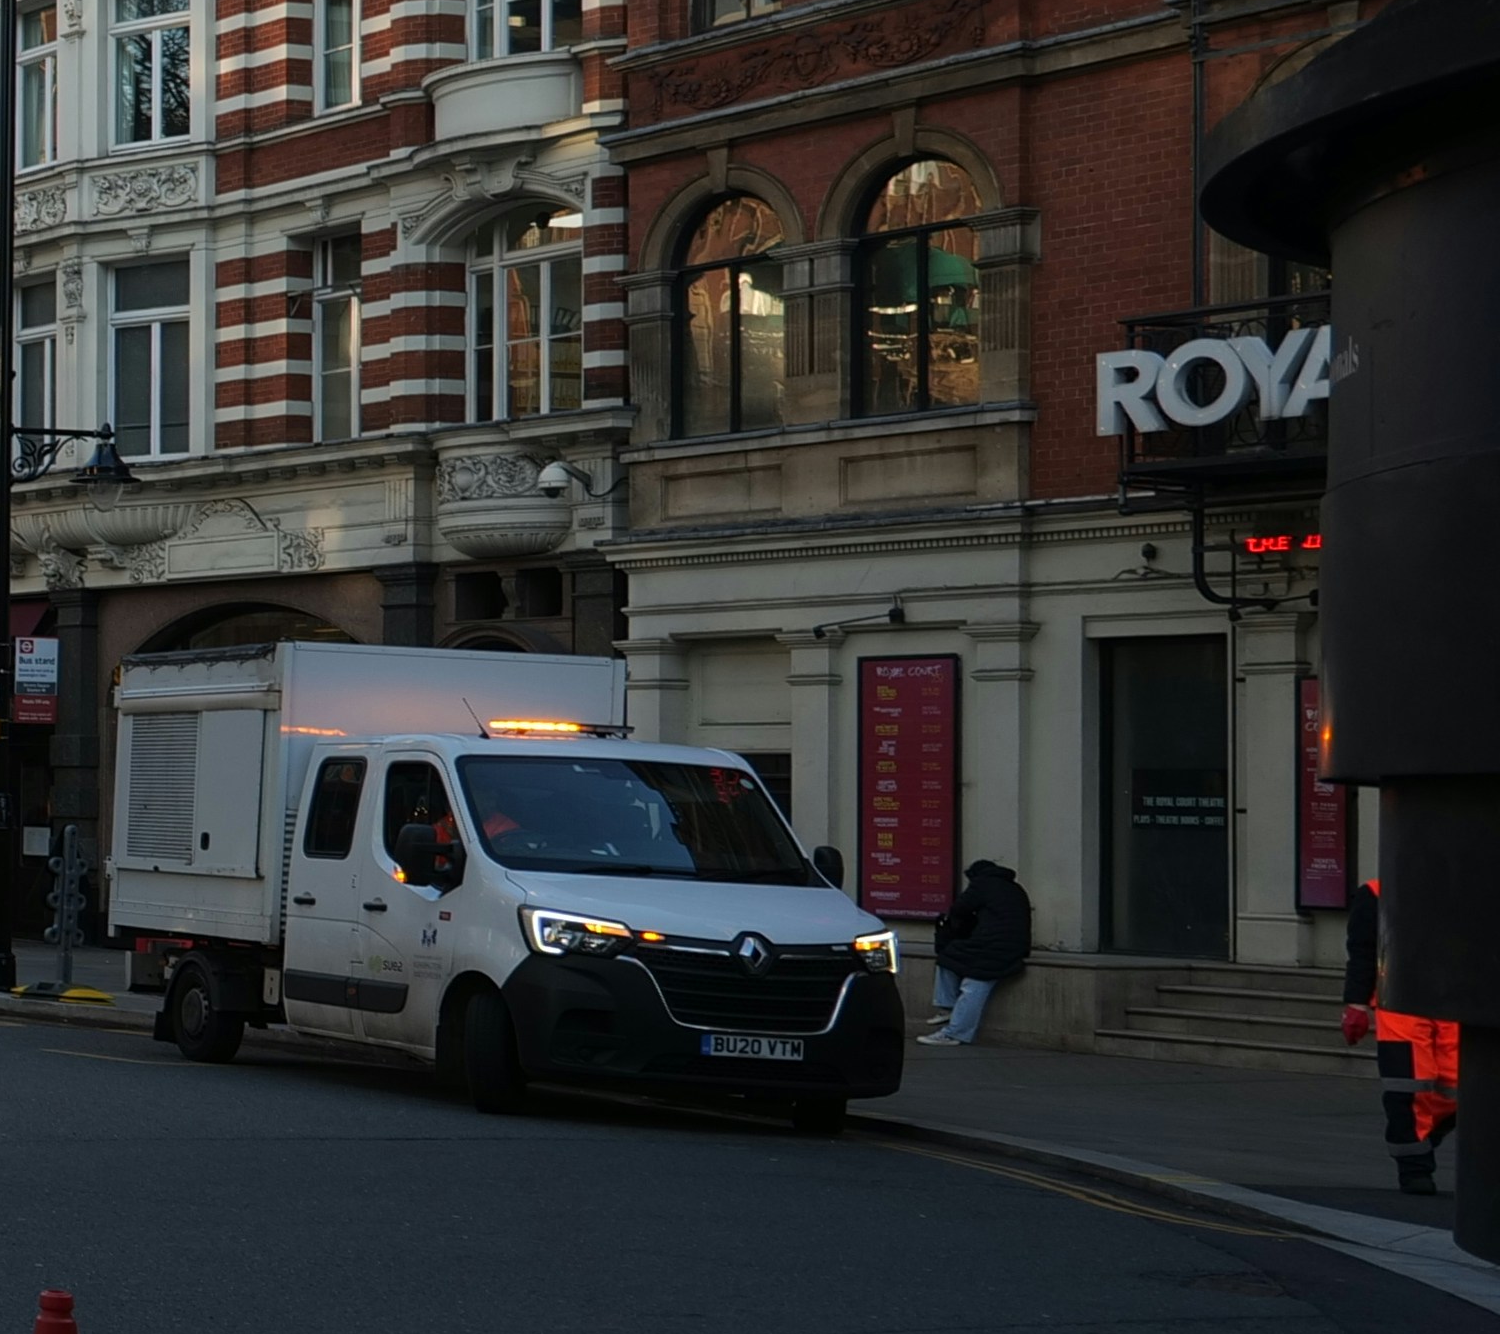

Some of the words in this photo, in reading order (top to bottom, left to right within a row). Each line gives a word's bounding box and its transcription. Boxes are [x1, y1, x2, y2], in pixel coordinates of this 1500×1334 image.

[1096, 324, 1331, 436] ROYA
[19, 657, 33, 665] Bus
[35, 657, 55, 666] stand
[908, 665, 941, 677] COURT
[713, 1037, 762, 1055] BU20
[768, 1040, 801, 1057] VTM
